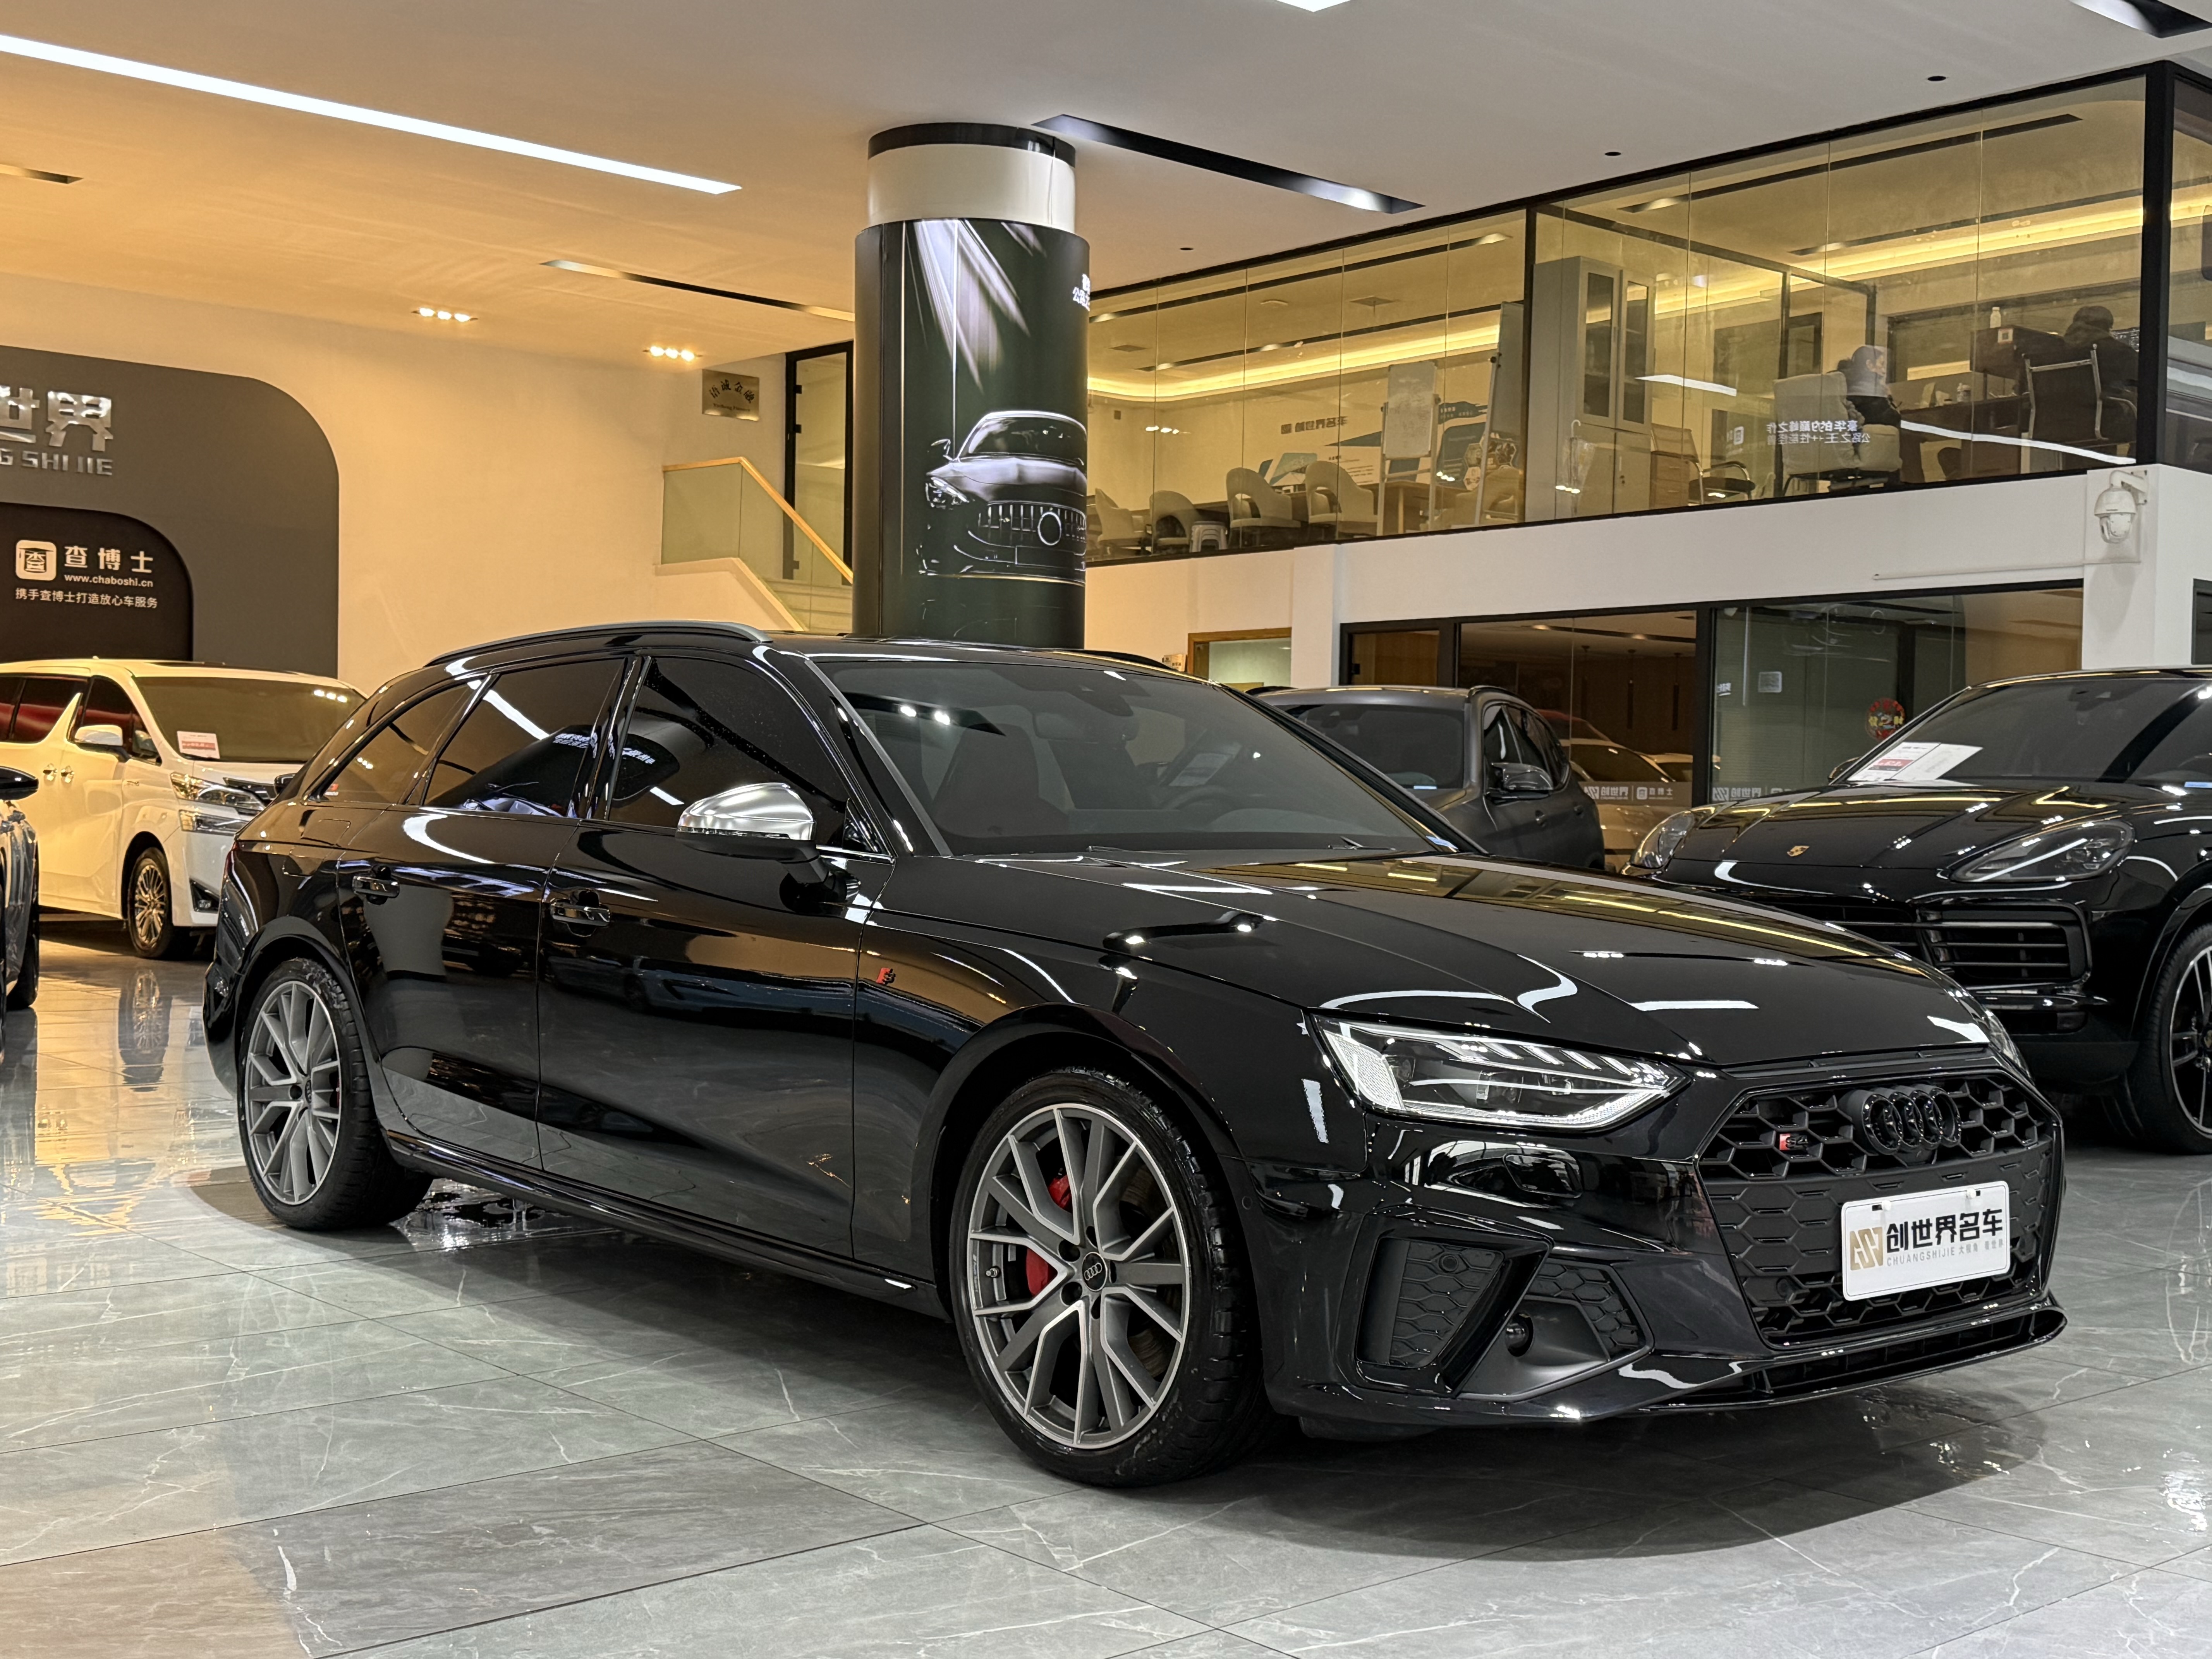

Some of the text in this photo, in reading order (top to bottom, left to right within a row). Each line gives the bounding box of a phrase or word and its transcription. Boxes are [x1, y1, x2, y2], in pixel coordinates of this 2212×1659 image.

[22, 450, 69, 471] SHI
[64, 546, 153, 573] 查博士
[64, 574, 153, 587] www.chaboshi.cn
[15, 587, 158, 608] 携手查博士打造放心车服务
[1886, 1209, 2002, 1253] 创世界名车
[1887, 1247, 1955, 1266] CHUANGSHIJIE
